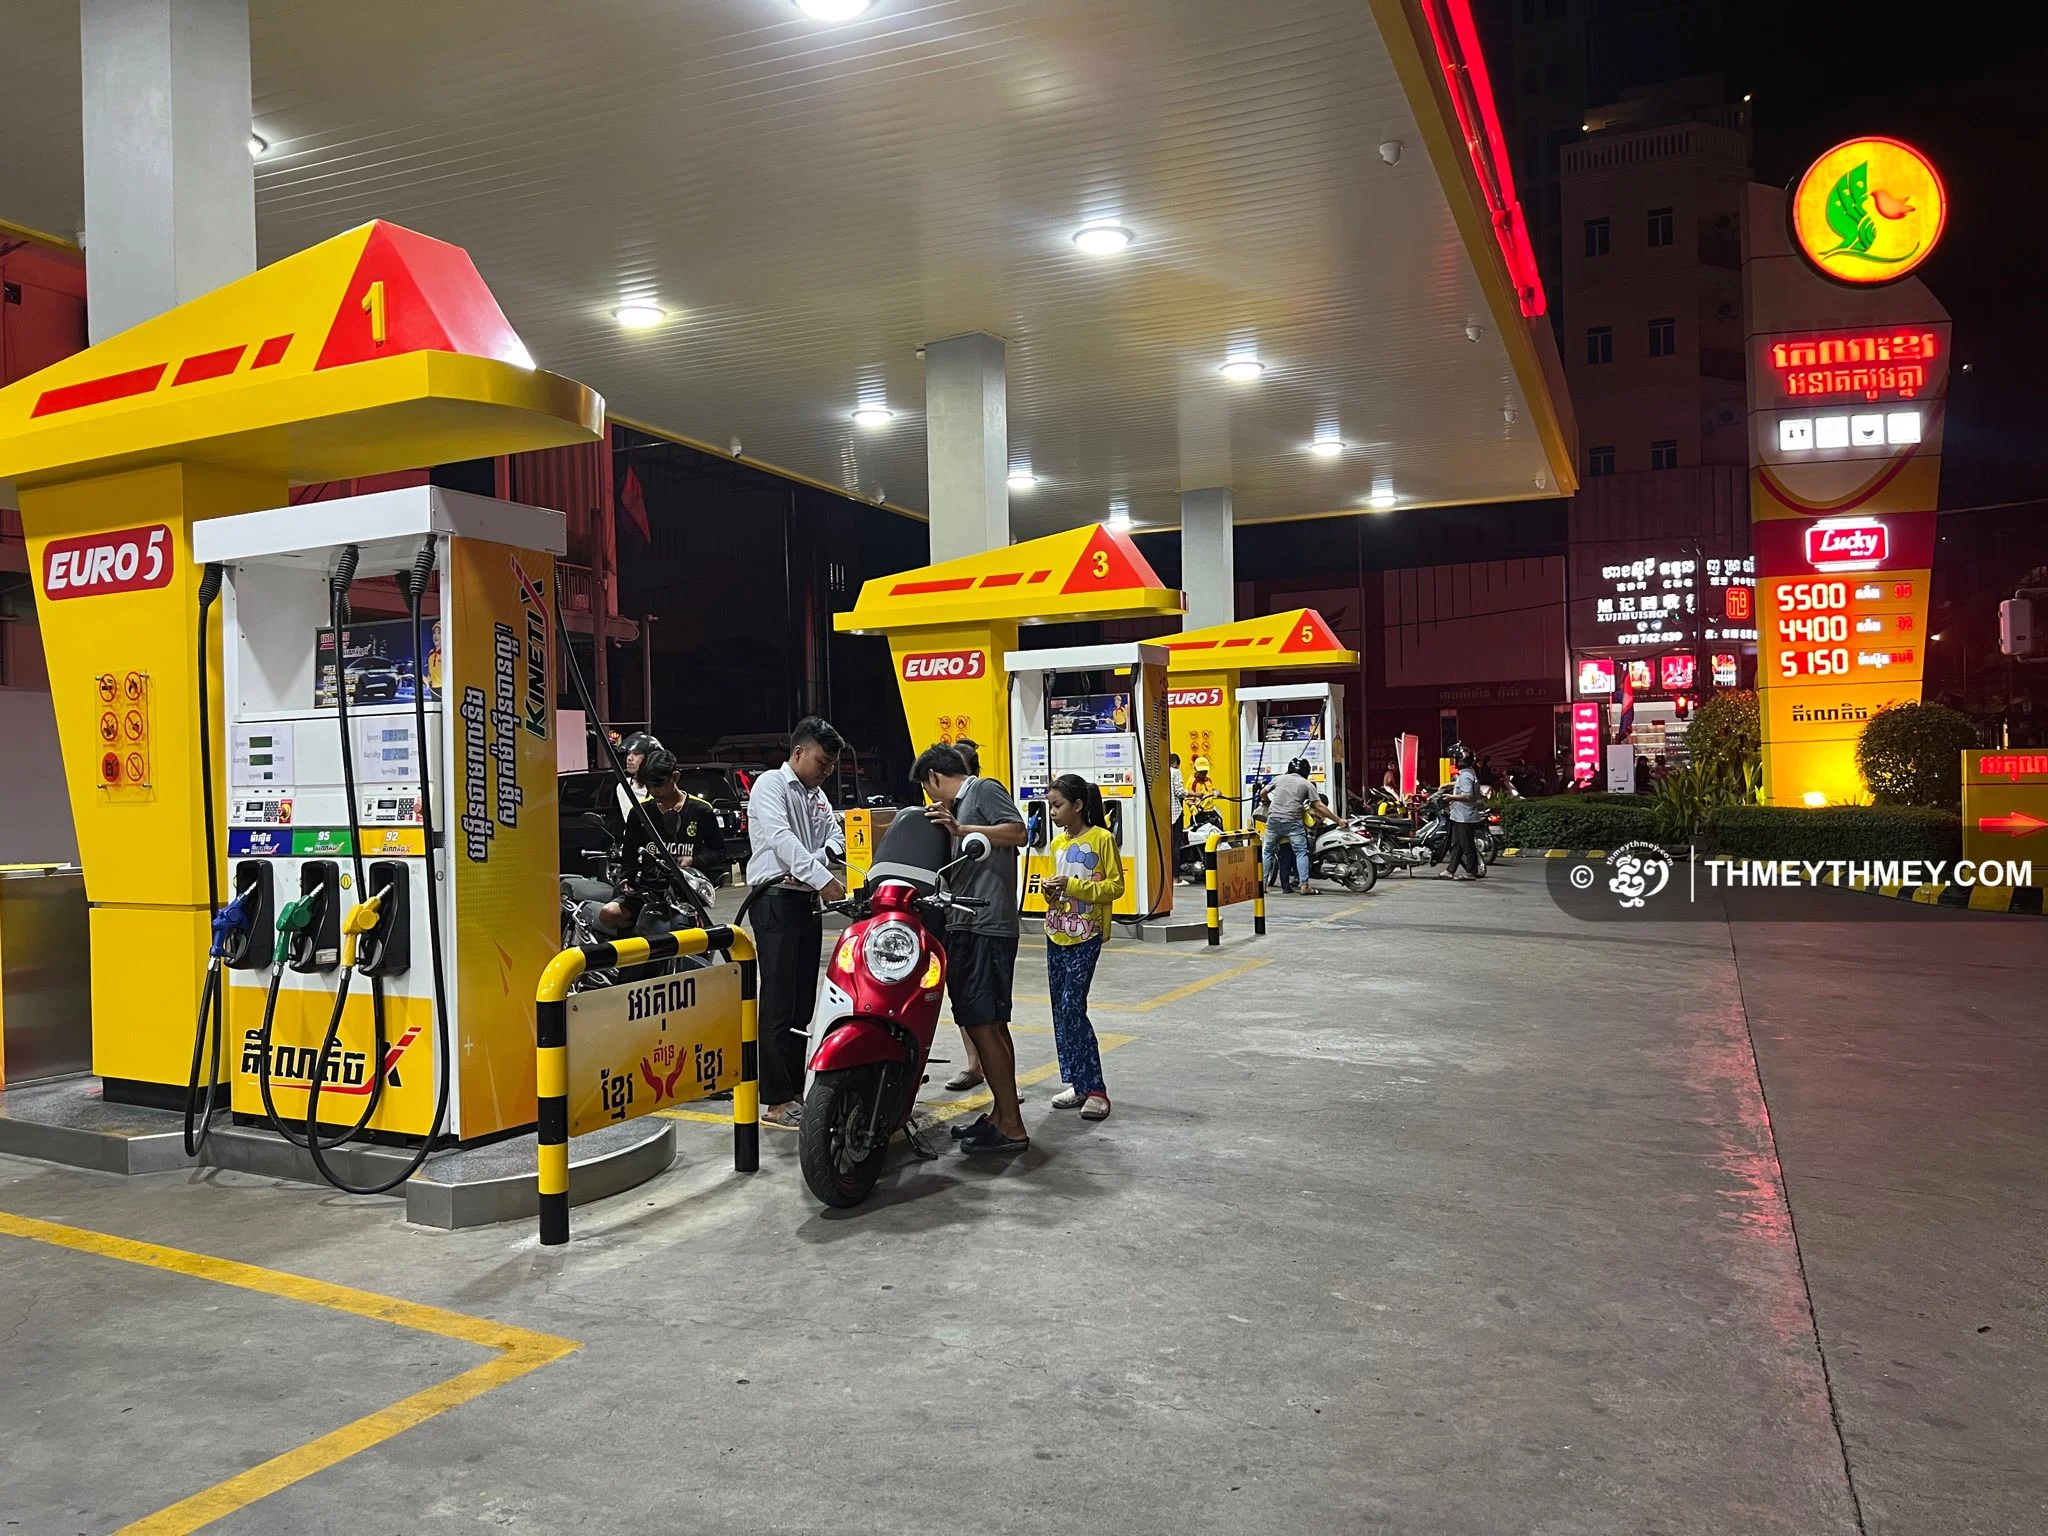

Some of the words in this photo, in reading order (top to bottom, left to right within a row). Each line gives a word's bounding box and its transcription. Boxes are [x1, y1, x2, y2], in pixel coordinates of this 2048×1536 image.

[361, 281, 386, 341] 1
[1819, 529, 1878, 556] Lucky
[48, 543, 139, 590] EURO
[143, 528, 165, 580] 5
[1093, 551, 1109, 578] 3
[1777, 583, 1846, 611] 5500
[1893, 583, 1913, 598] 95
[1301, 626, 1314, 643] 5
[1779, 615, 1848, 642] 4400
[1896, 616, 1913, 631] 92
[514, 564, 548, 740] KINETIX
[905, 657, 964, 677] EURO
[966, 652, 981, 675] 5
[1209, 689, 1219, 704] 5
[318, 831, 331, 841] 95
[386, 831, 399, 841] 92
[628, 977, 696, 1031] អរគុណ
[600, 1068, 633, 1120] ខ្មែរ
[654, 1039, 675, 1066] គាំទ្រ
[695, 1043, 723, 1091] ខ្មែរ
